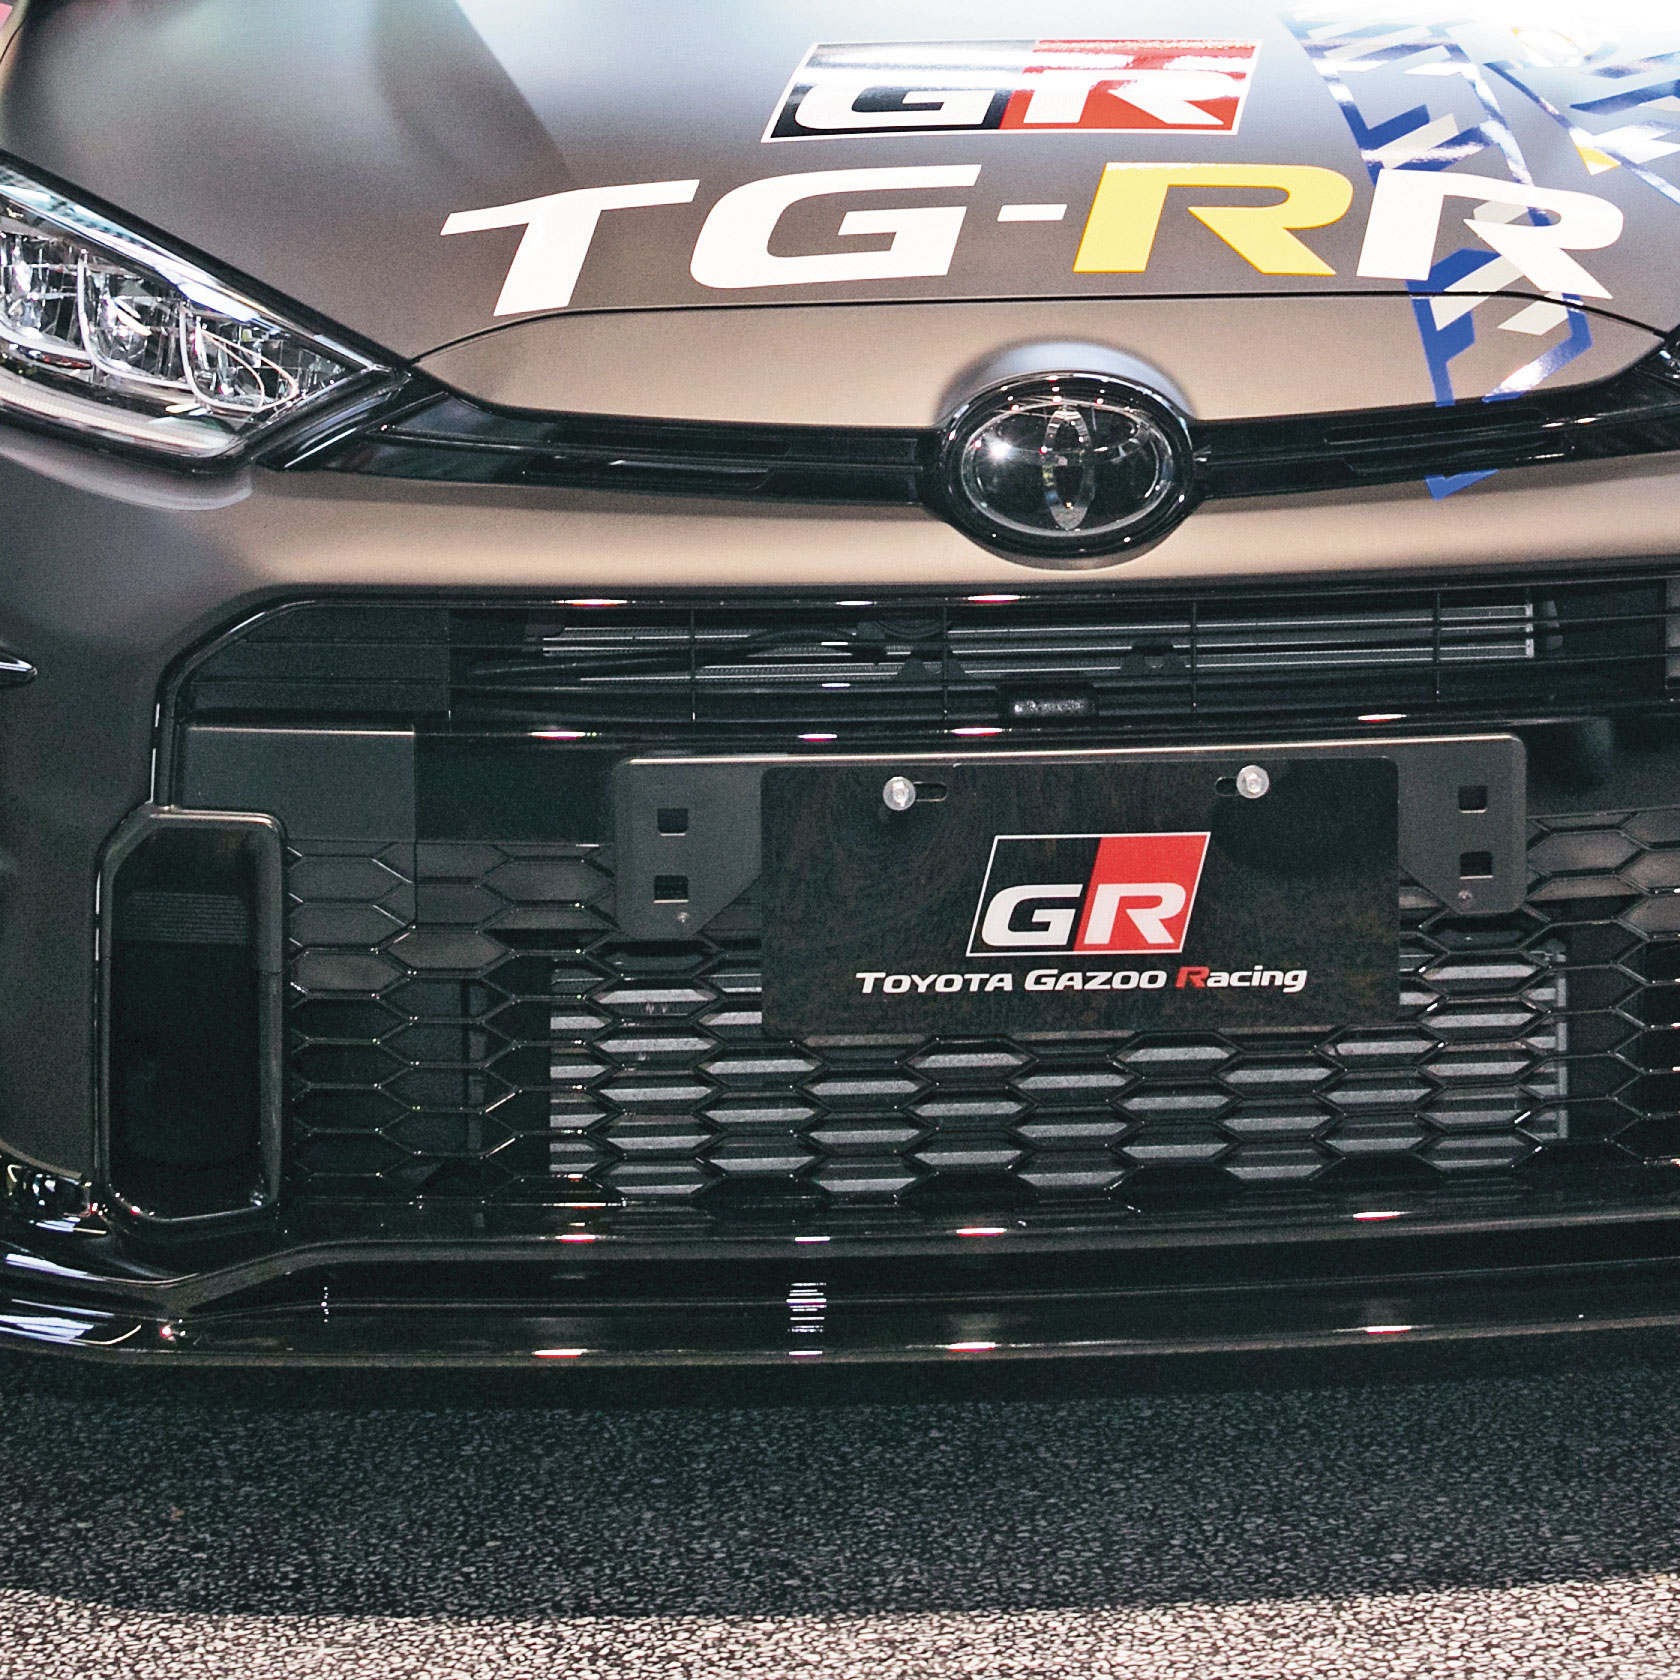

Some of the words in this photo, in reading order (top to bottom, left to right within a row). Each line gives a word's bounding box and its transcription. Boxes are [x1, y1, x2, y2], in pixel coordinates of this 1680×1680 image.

[439, 159, 1625, 318] TG-RR
[978, 881, 1191, 950] GR
[855, 969, 1017, 996] TOYOTA
[1022, 966, 1168, 993] GAZOO
[1175, 963, 1308, 994] Racing
